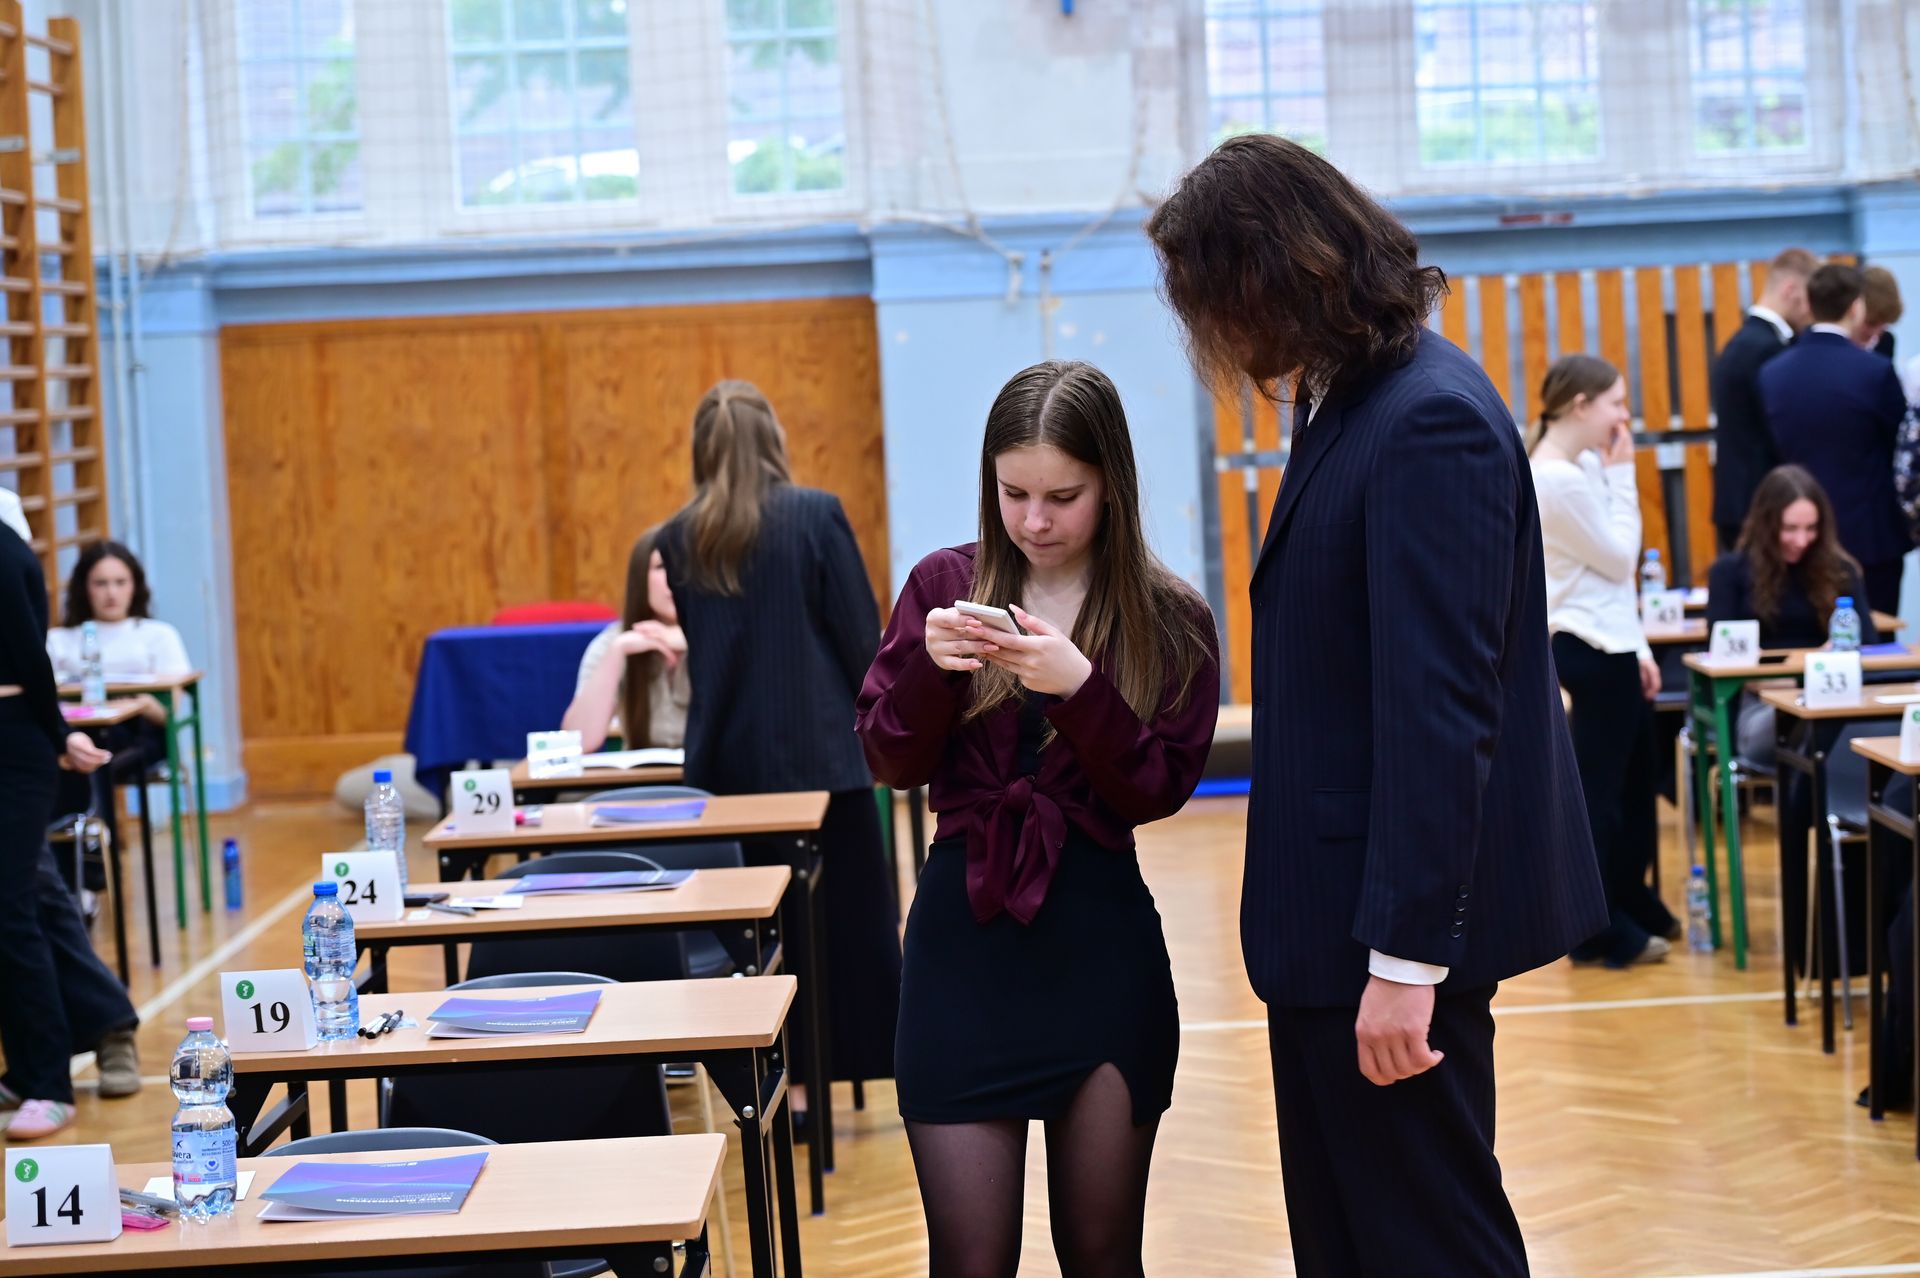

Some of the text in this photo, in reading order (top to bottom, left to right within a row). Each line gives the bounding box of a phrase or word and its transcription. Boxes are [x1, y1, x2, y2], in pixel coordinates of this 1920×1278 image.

[1820, 672, 1848, 694] 33
[472, 792, 500, 815] 29
[343, 879, 377, 905] 24
[249, 1001, 291, 1034] 19
[30, 1184, 84, 1228] 14
